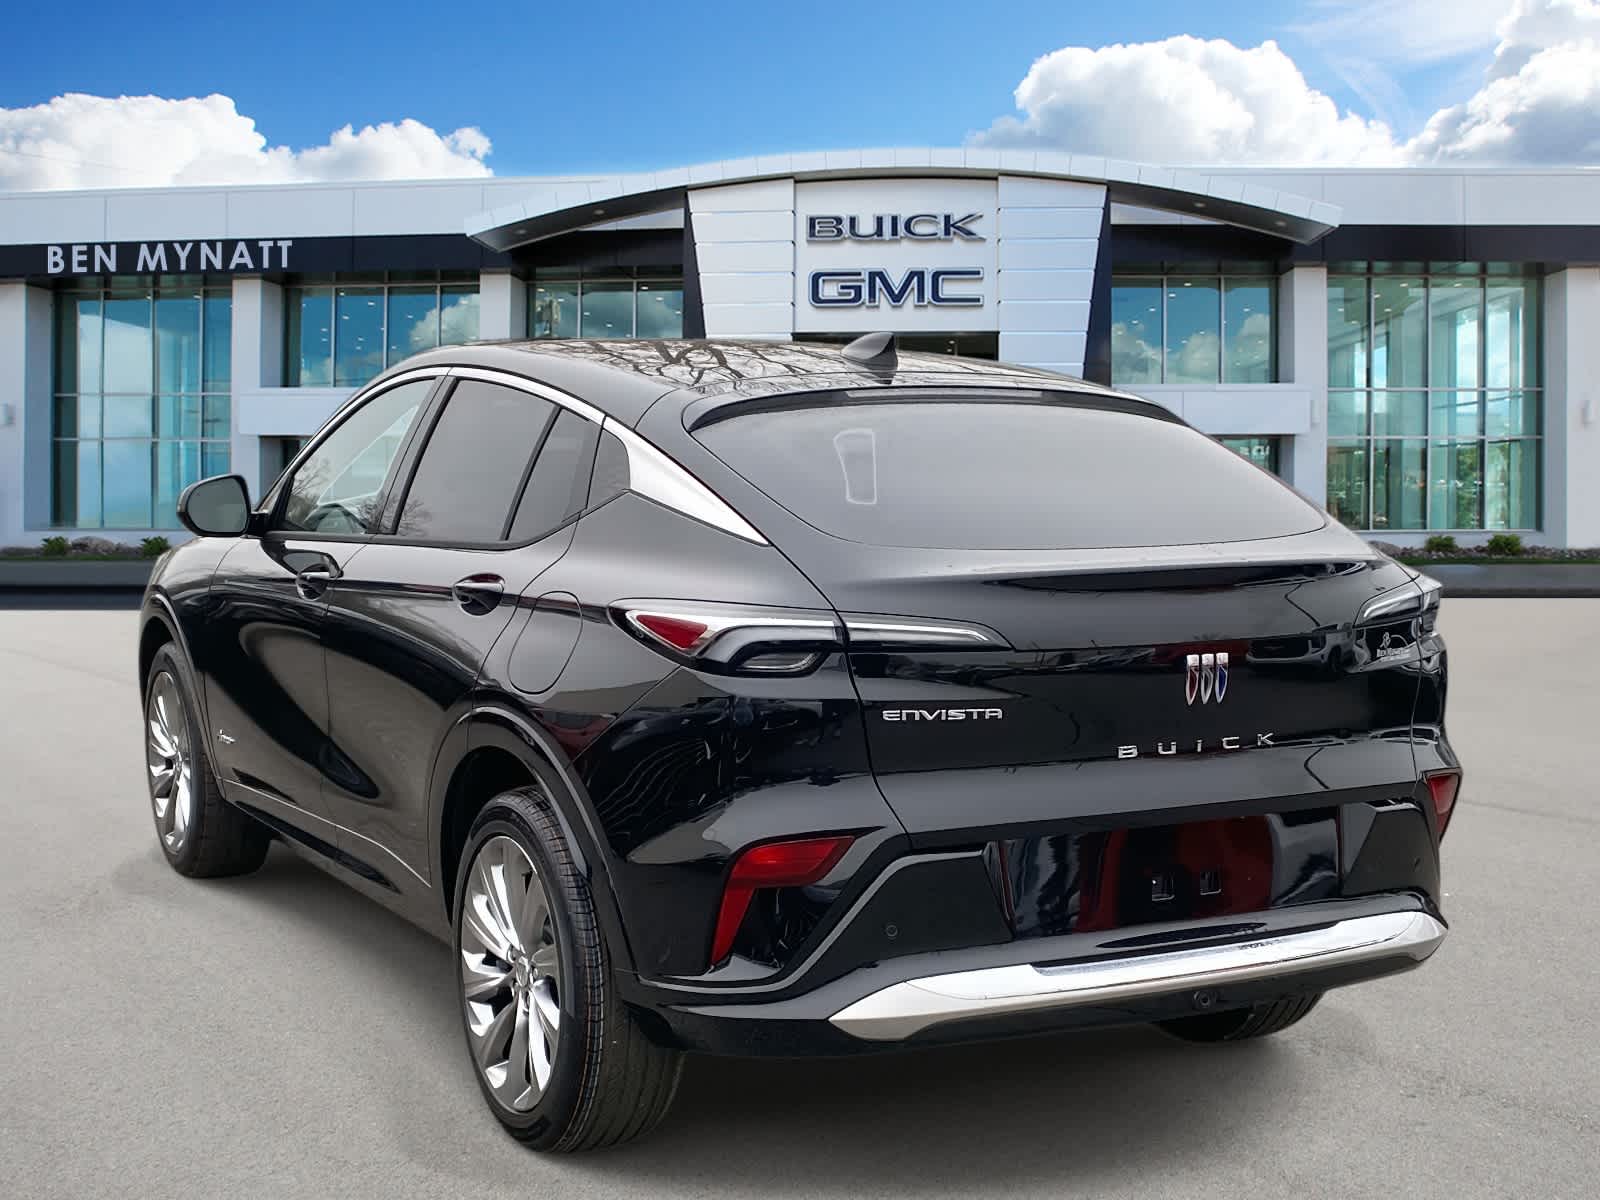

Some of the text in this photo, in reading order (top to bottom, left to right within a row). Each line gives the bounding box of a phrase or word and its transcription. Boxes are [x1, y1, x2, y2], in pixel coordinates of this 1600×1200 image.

[807, 213, 986, 242] BUICK
[47, 240, 293, 274] BEN MYNATT
[808, 267, 984, 308] GMC
[882, 708, 1003, 721] ENVISTA
[1117, 732, 1275, 759] BUICK
